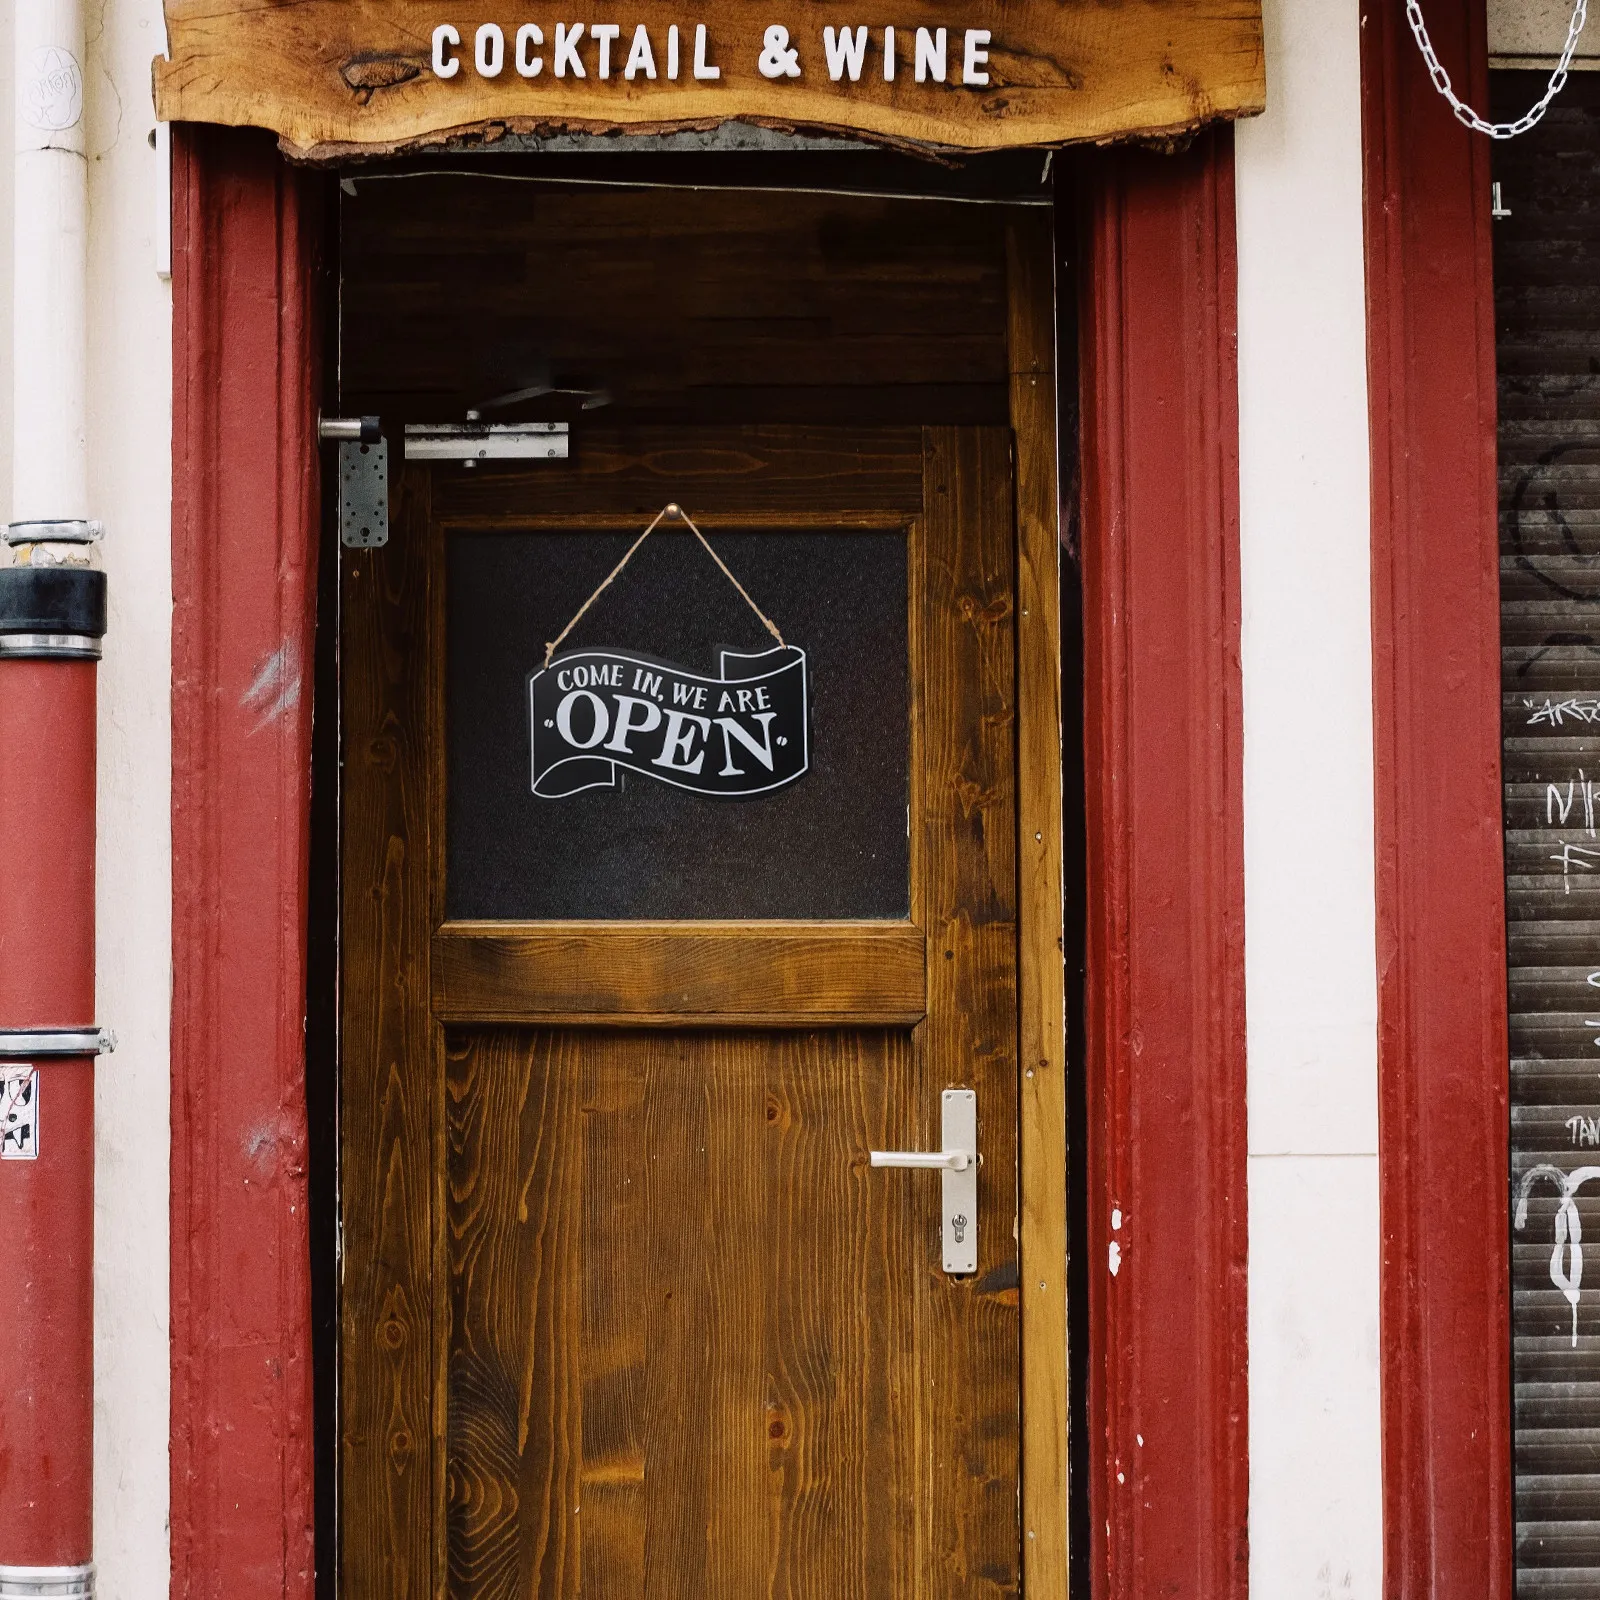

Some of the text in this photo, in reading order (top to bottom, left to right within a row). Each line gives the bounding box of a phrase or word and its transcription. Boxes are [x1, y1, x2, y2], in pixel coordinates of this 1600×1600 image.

[431, 22, 992, 85] COCKTAIL & WINE
[556, 664, 772, 713] COME IN, WE ARE
[556, 690, 778, 777] OPEN
